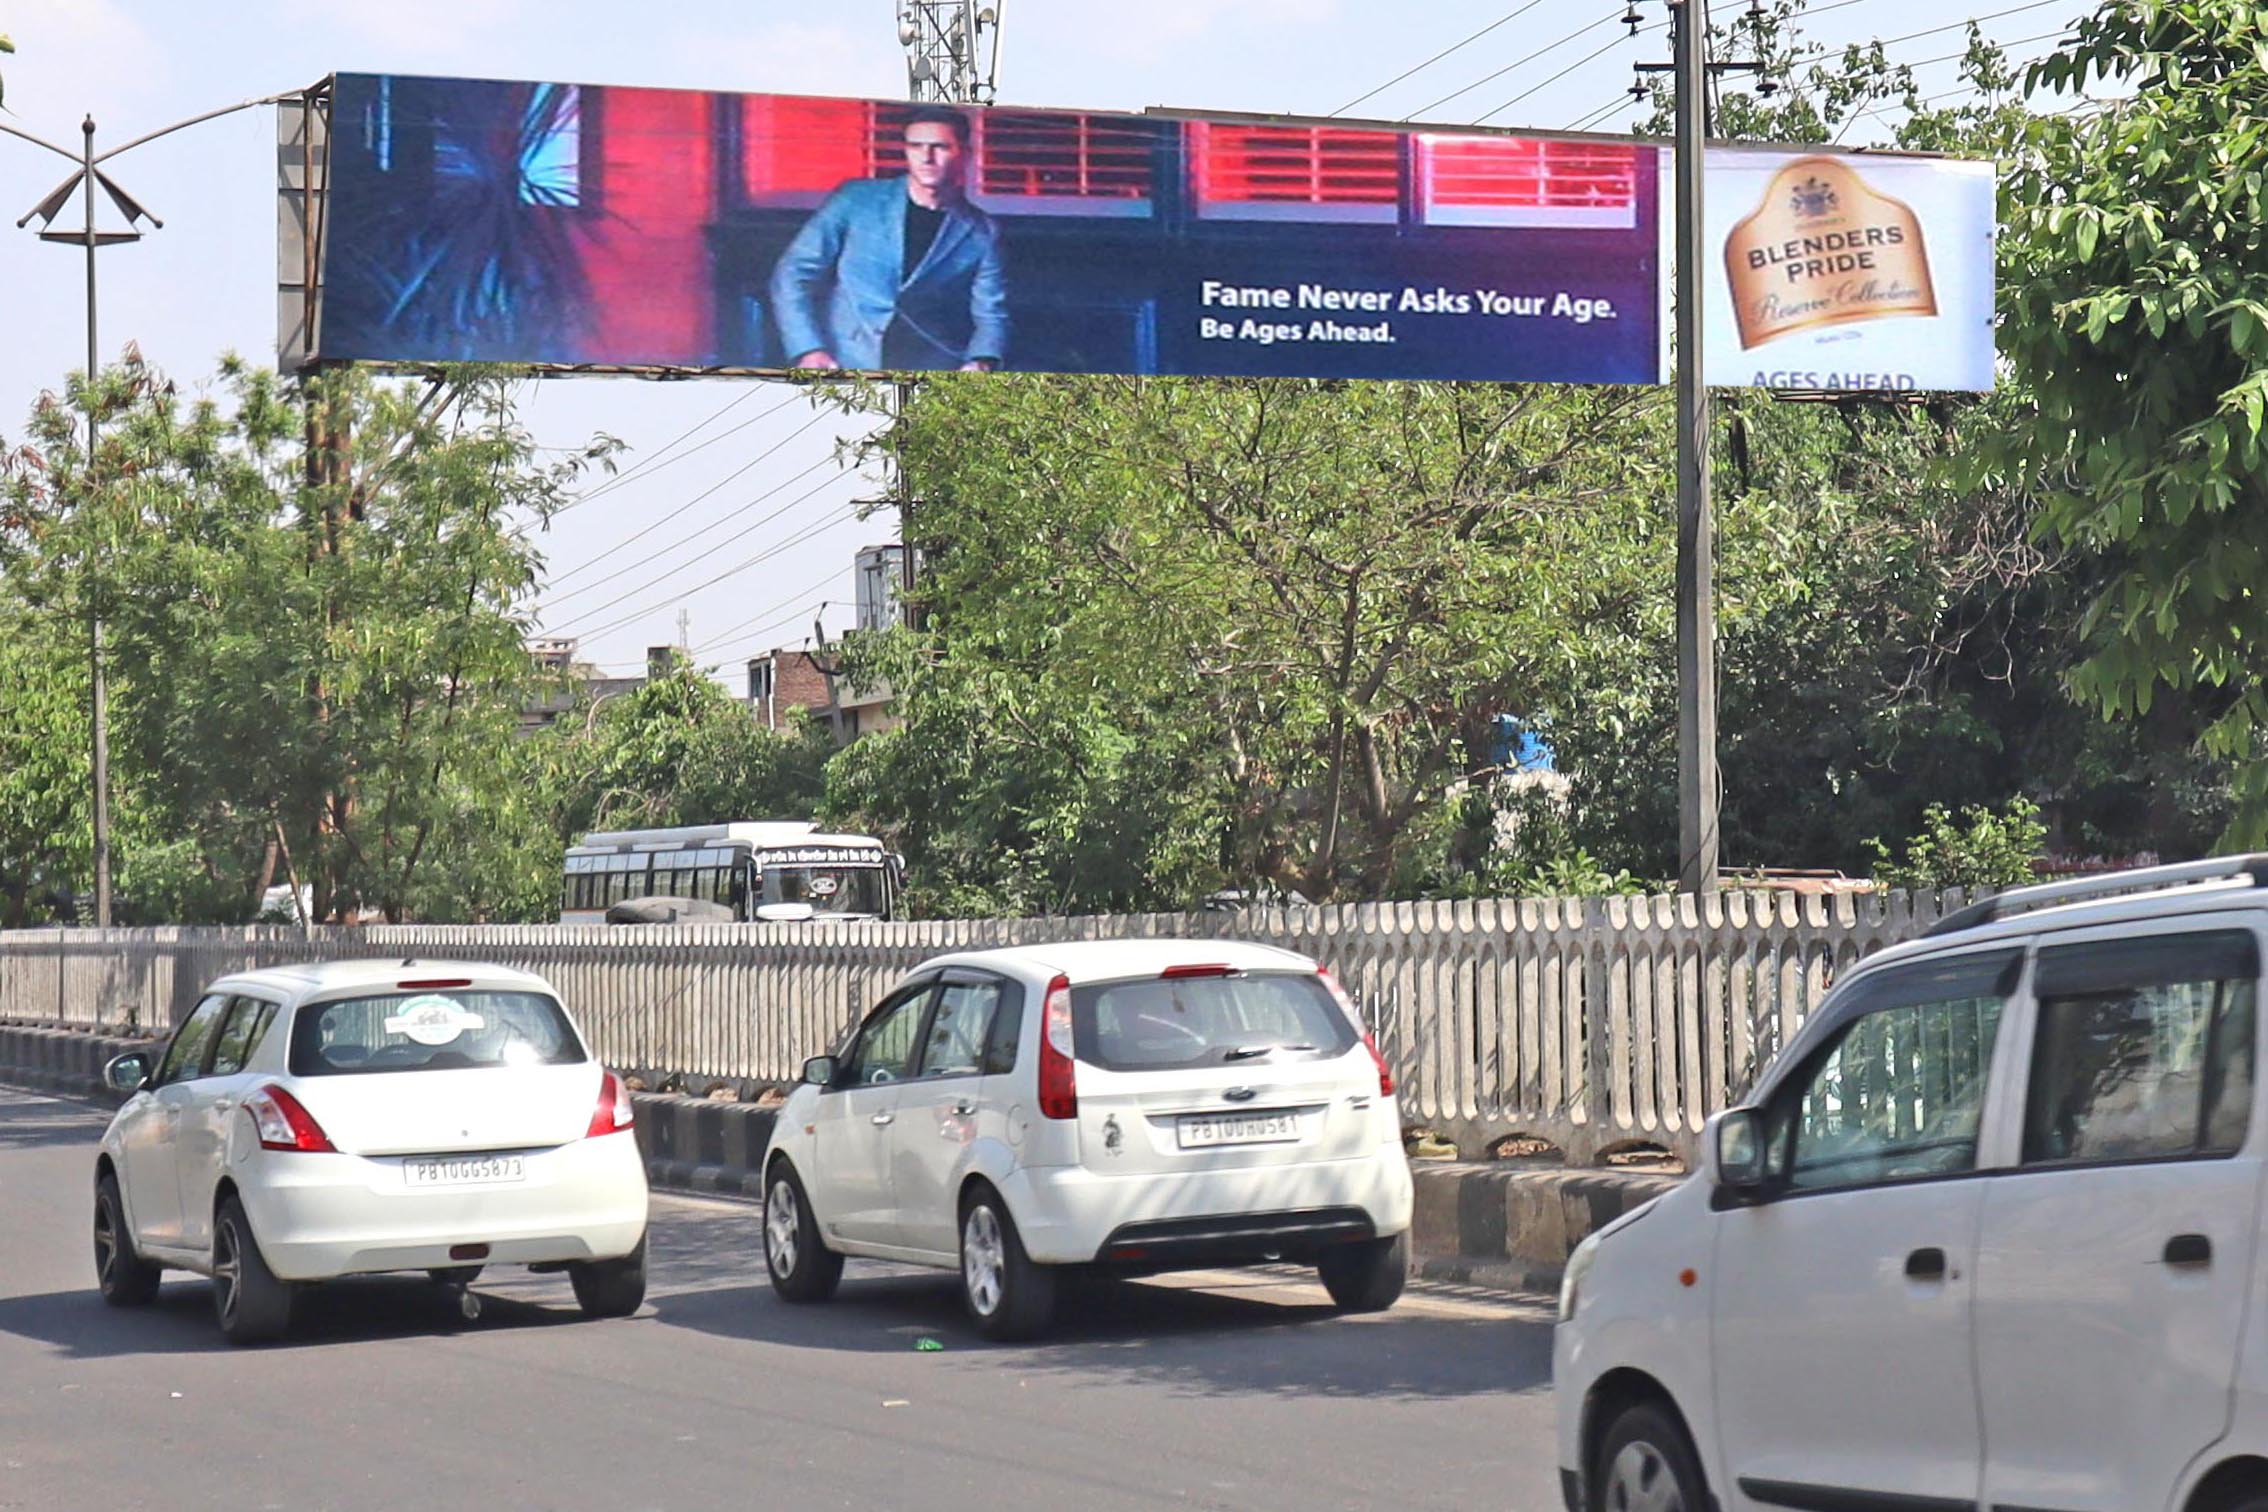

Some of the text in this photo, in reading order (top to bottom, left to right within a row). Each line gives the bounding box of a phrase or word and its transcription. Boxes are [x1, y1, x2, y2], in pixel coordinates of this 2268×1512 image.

[1748, 226, 1905, 269] BLENDERS
[1786, 251, 1876, 283] PRIDE
[1202, 281, 1618, 323] Fame Never Asks Your Age.
[1201, 319, 1396, 345] Be Ages Ahead.
